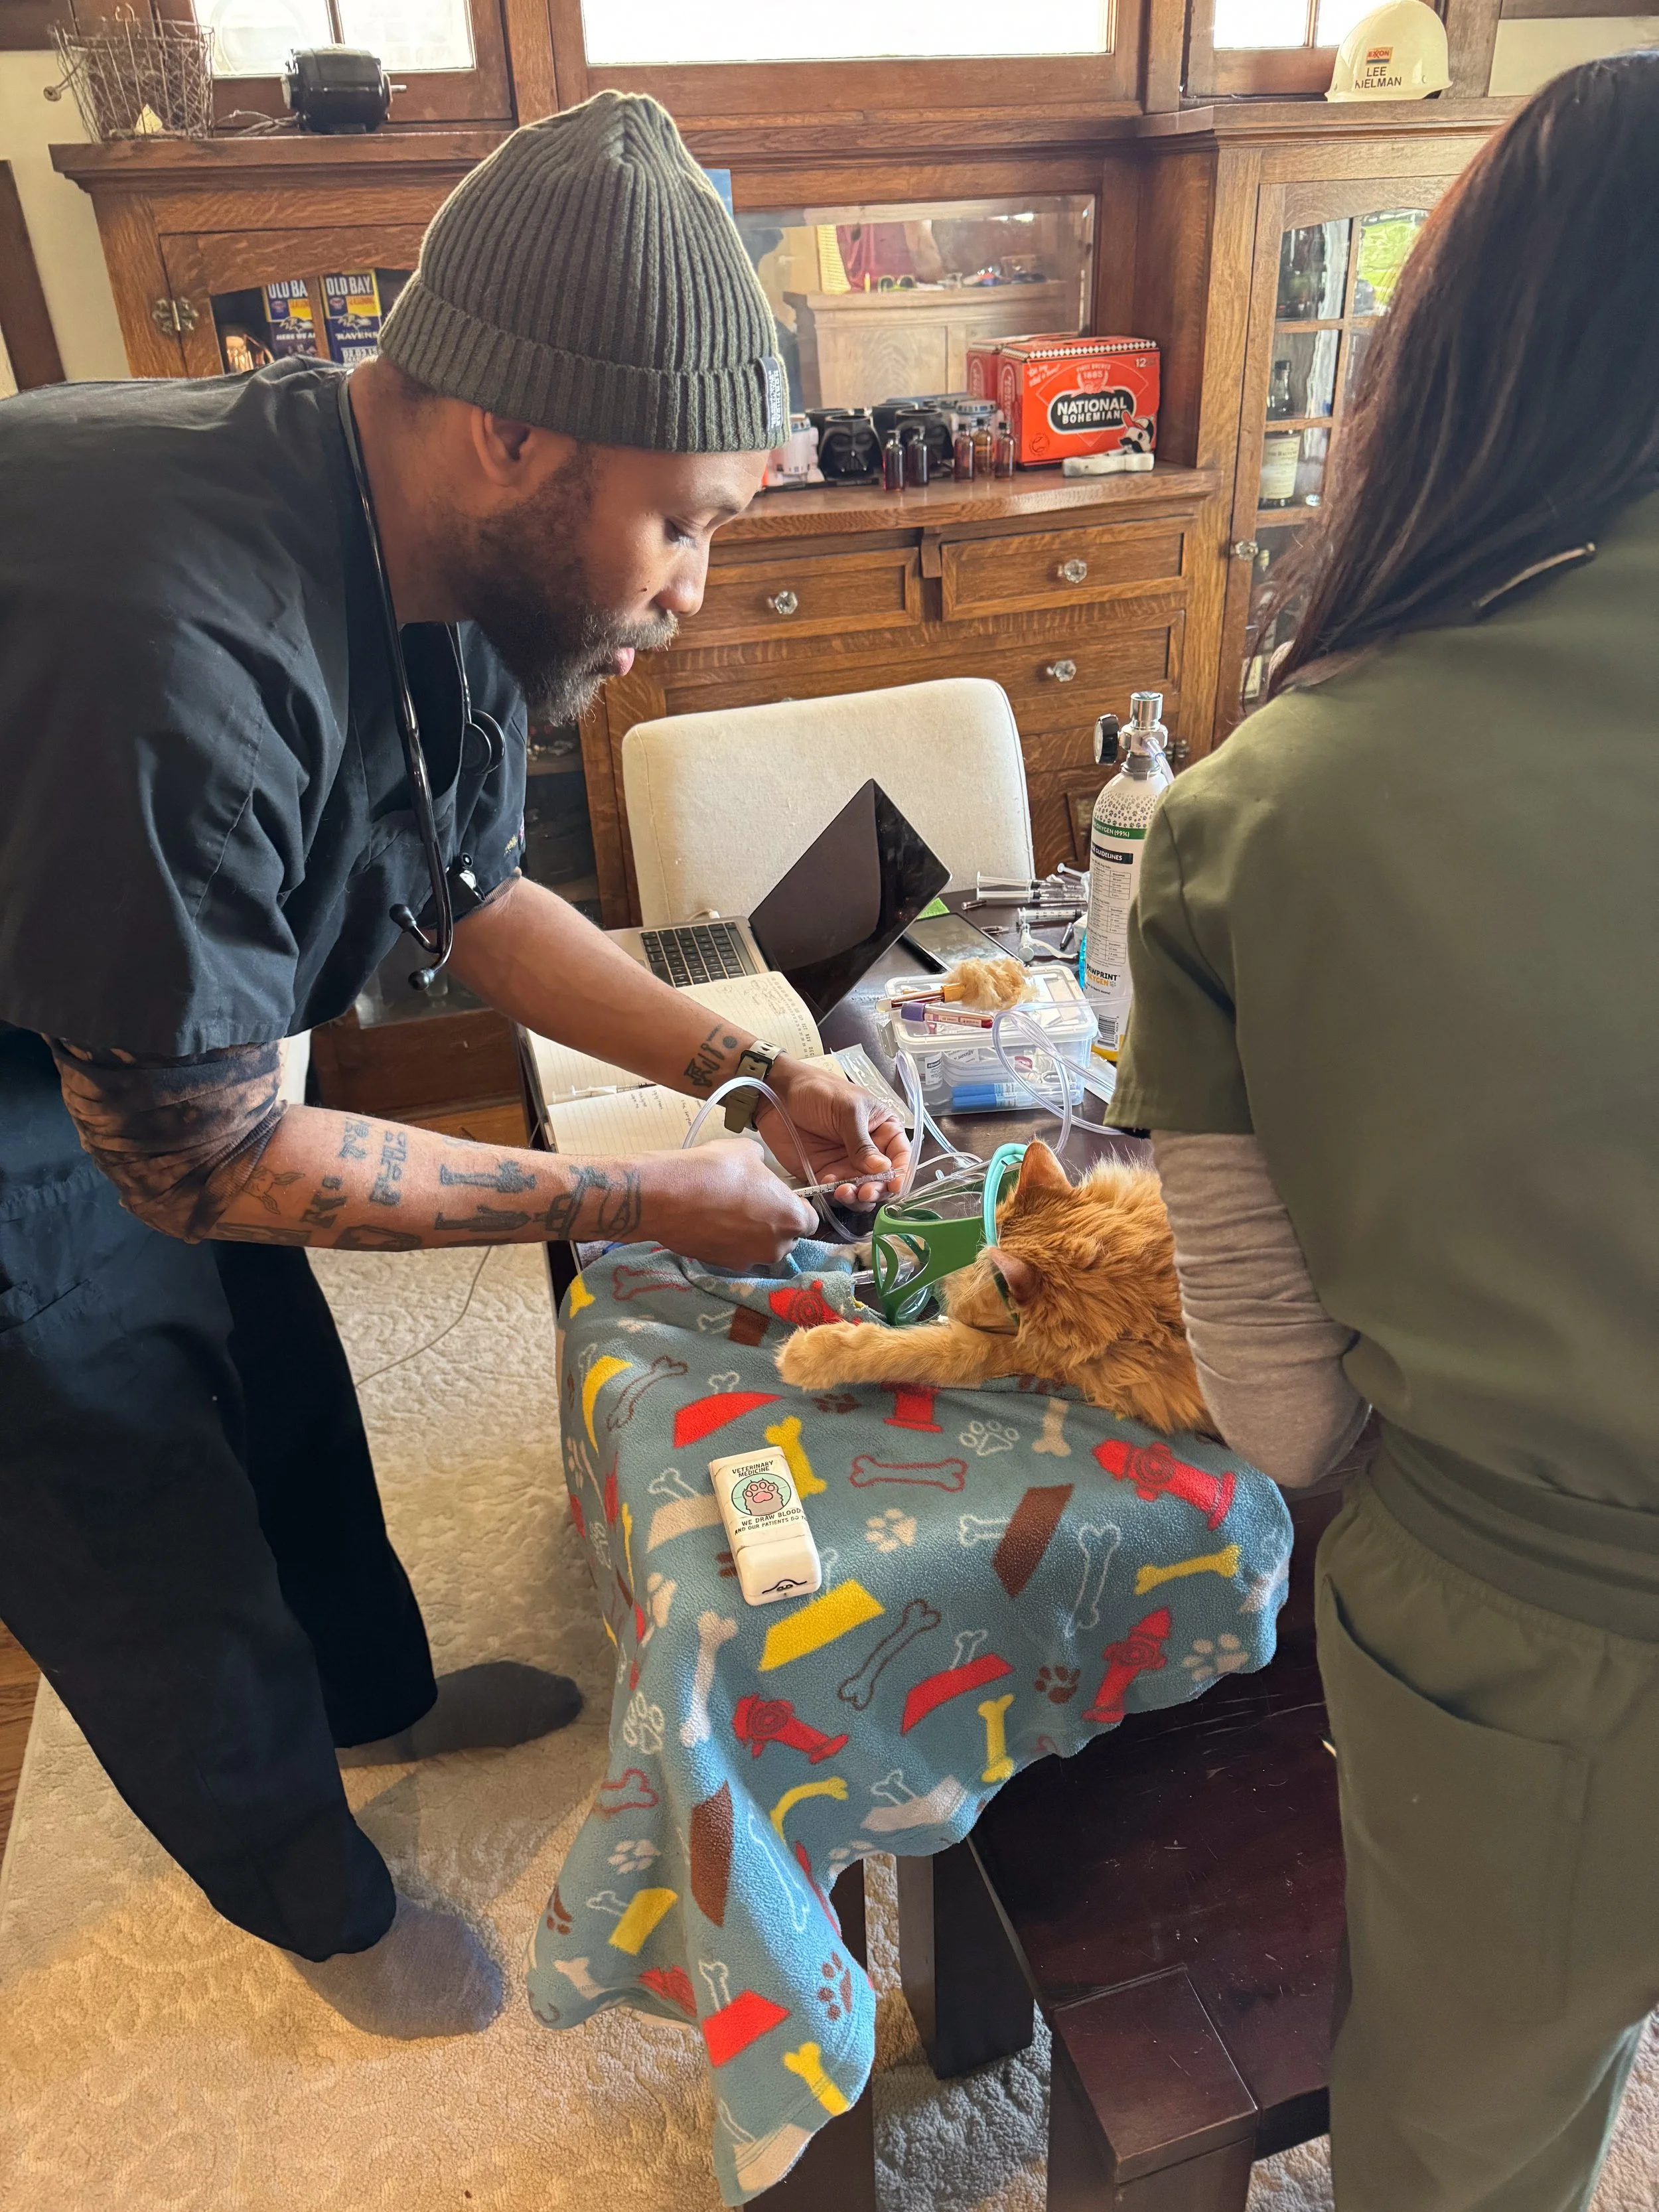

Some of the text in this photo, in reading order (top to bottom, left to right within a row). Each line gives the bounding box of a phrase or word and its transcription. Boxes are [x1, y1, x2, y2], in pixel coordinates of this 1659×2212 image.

[1368, 50, 1390, 58] EXXON
[1366, 66, 1387, 77] LEE
[268, 279, 309, 299] OLD BA
[326, 275, 372, 296] OLD BAY
[1135, 358, 1147, 368] 12
[1056, 396, 1127, 416] NATIONAL
[1062, 411, 1121, 425] BOHEMIAN
[1096, 824, 1114, 834] OXYGEN
[1096, 848, 1123, 861] GUIDELINES
[1086, 964, 1118, 981] PAWPRINT
[1086, 971, 1109, 986] OXYGEN
[732, 1460, 774, 1474] VETERINARY
[738, 1465, 770, 1478] MEDICINE
[755, 1514, 775, 1523] DRAW
[778, 1508, 801, 1518] BLOOD
[735, 1526, 746, 1536] AND
[762, 1517, 789, 1528] PATIENTS
